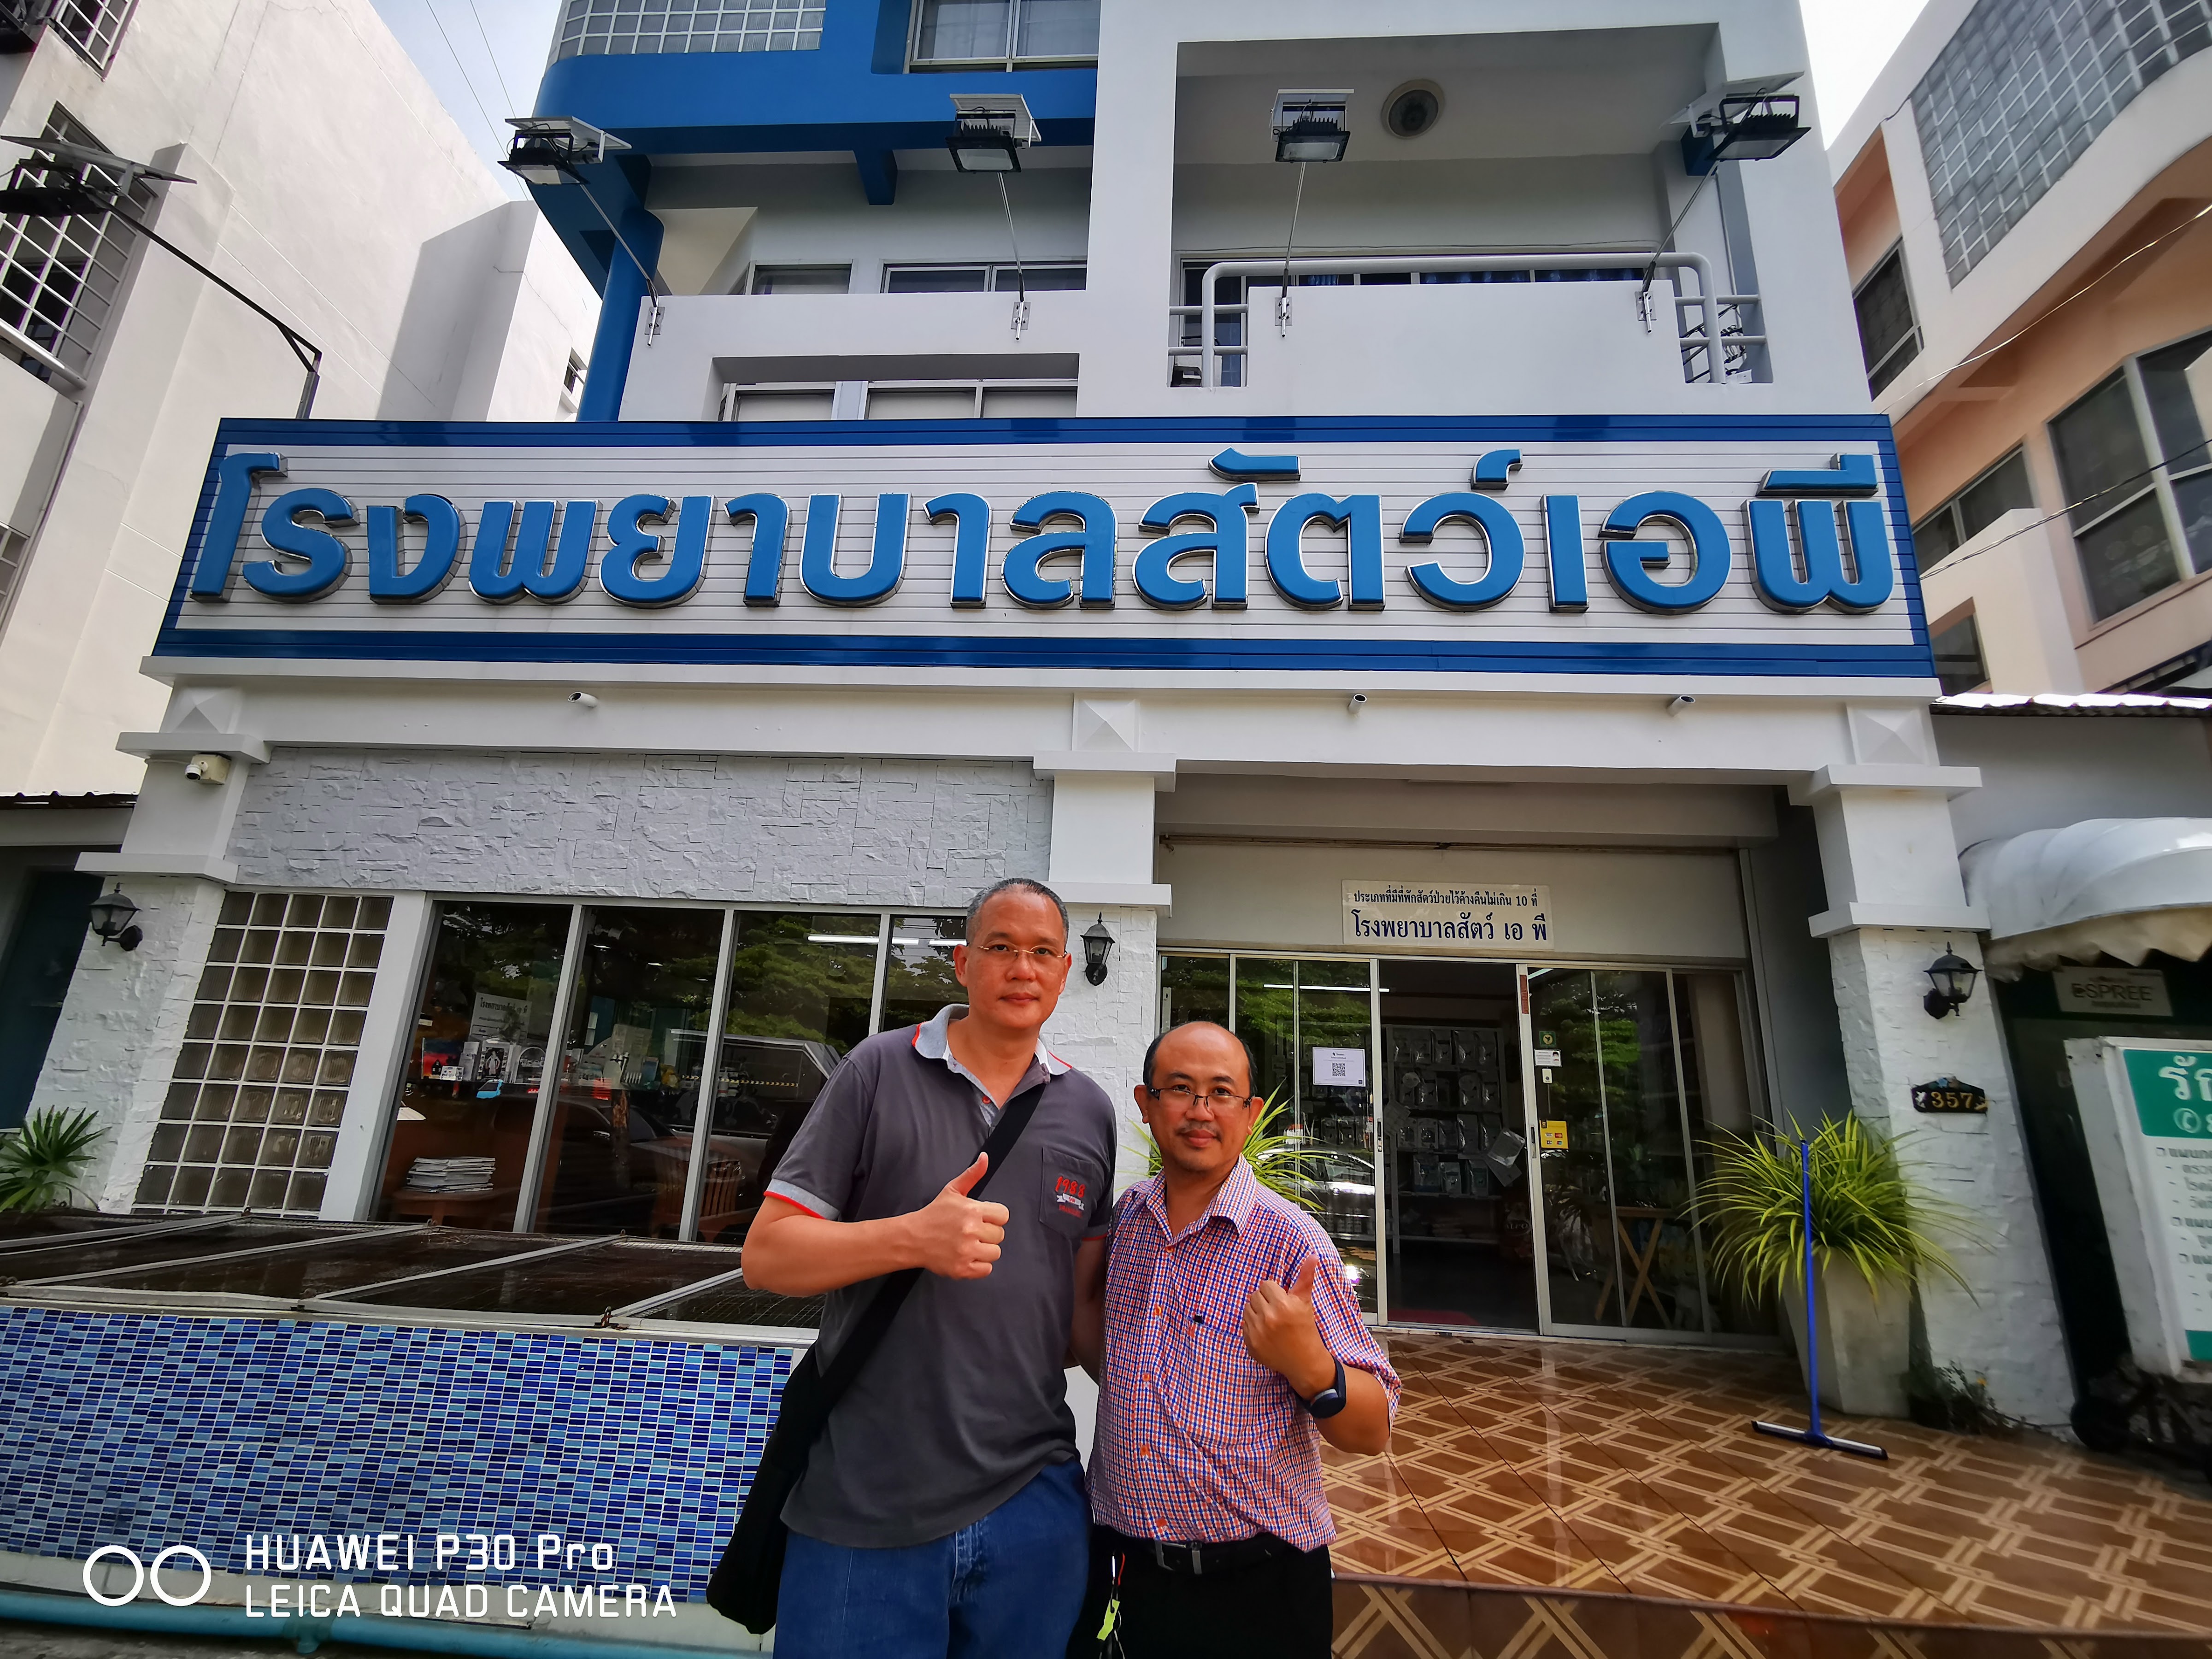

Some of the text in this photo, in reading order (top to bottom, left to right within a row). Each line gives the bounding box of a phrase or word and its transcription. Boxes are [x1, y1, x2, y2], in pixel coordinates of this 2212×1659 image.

[190, 449, 1894, 614] โรงพยาบาลสัตว์เอพี
[1353, 884, 1512, 906] ประเภทที่มีที่พักสัตว์ป่วยไว้ค้างคืนไม่เกิน
[1516, 895, 1528, 906] 10
[1351, 909, 1547, 941] โรงพยาบาลสัตว์ เอ พี
[1930, 1091, 1973, 1109] 357
[1055, 1176, 1086, 1198] 1988
